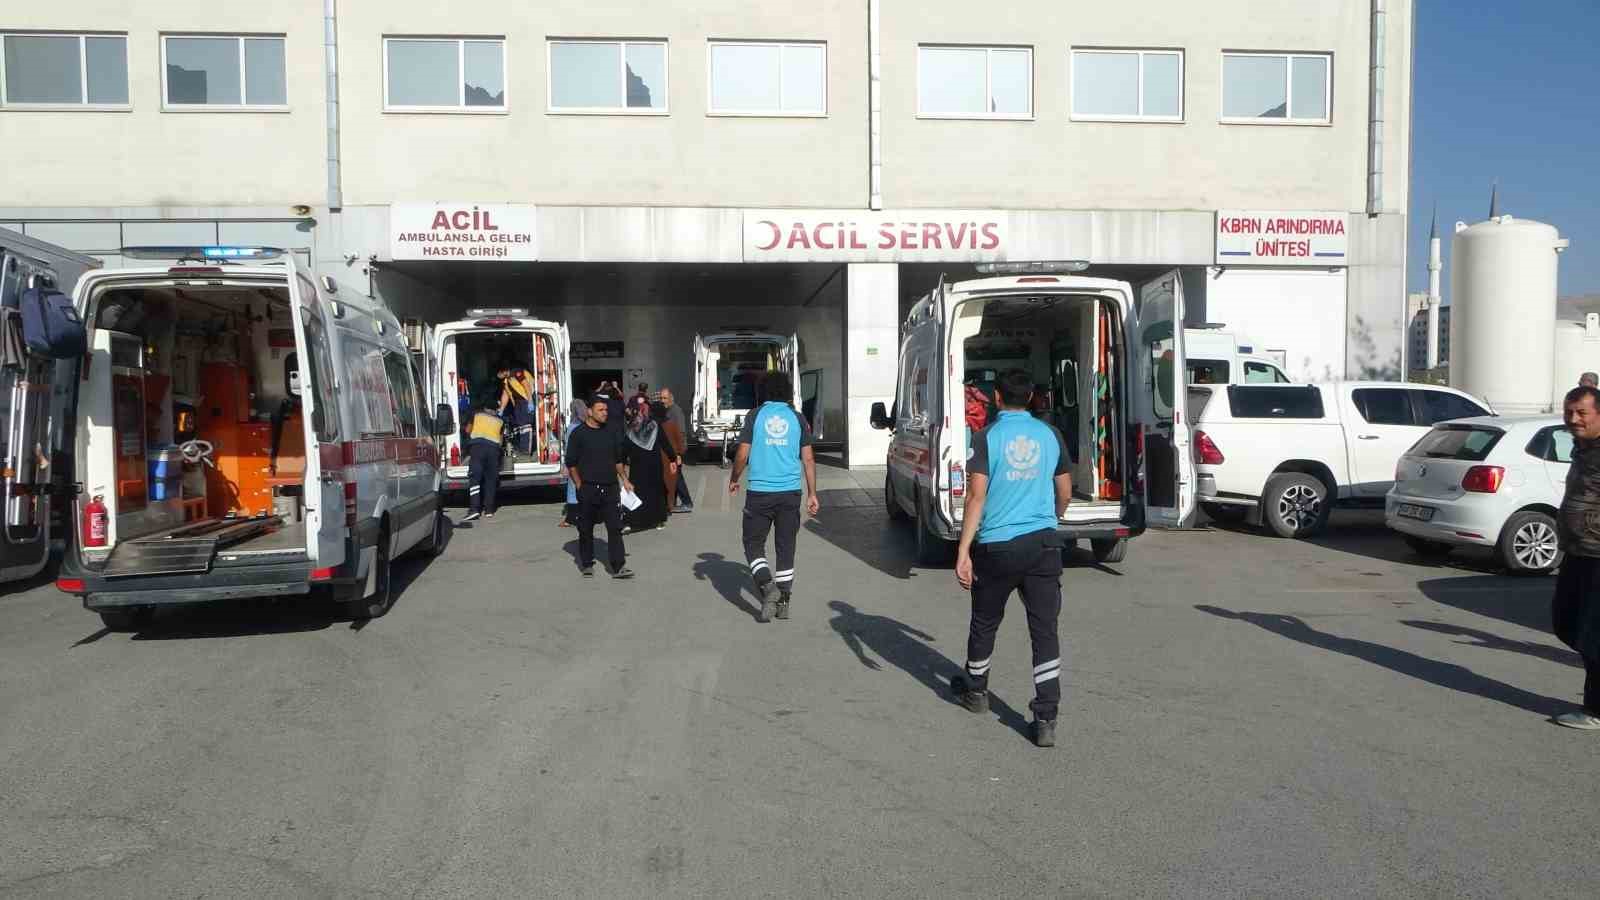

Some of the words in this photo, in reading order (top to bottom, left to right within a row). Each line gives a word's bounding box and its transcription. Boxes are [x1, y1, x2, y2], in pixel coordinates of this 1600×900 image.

[431, 206, 499, 231] ACİL
[1220, 217, 1261, 234] KBRN
[1265, 219, 1345, 235] ARINDIRMA
[398, 232, 486, 242] AMBULANSLA
[489, 234, 532, 243] GELEN
[422, 246, 465, 256] HASTA
[469, 245, 508, 258] GİRİŞİ
[1256, 238, 1311, 257] ÜNİTESİ
